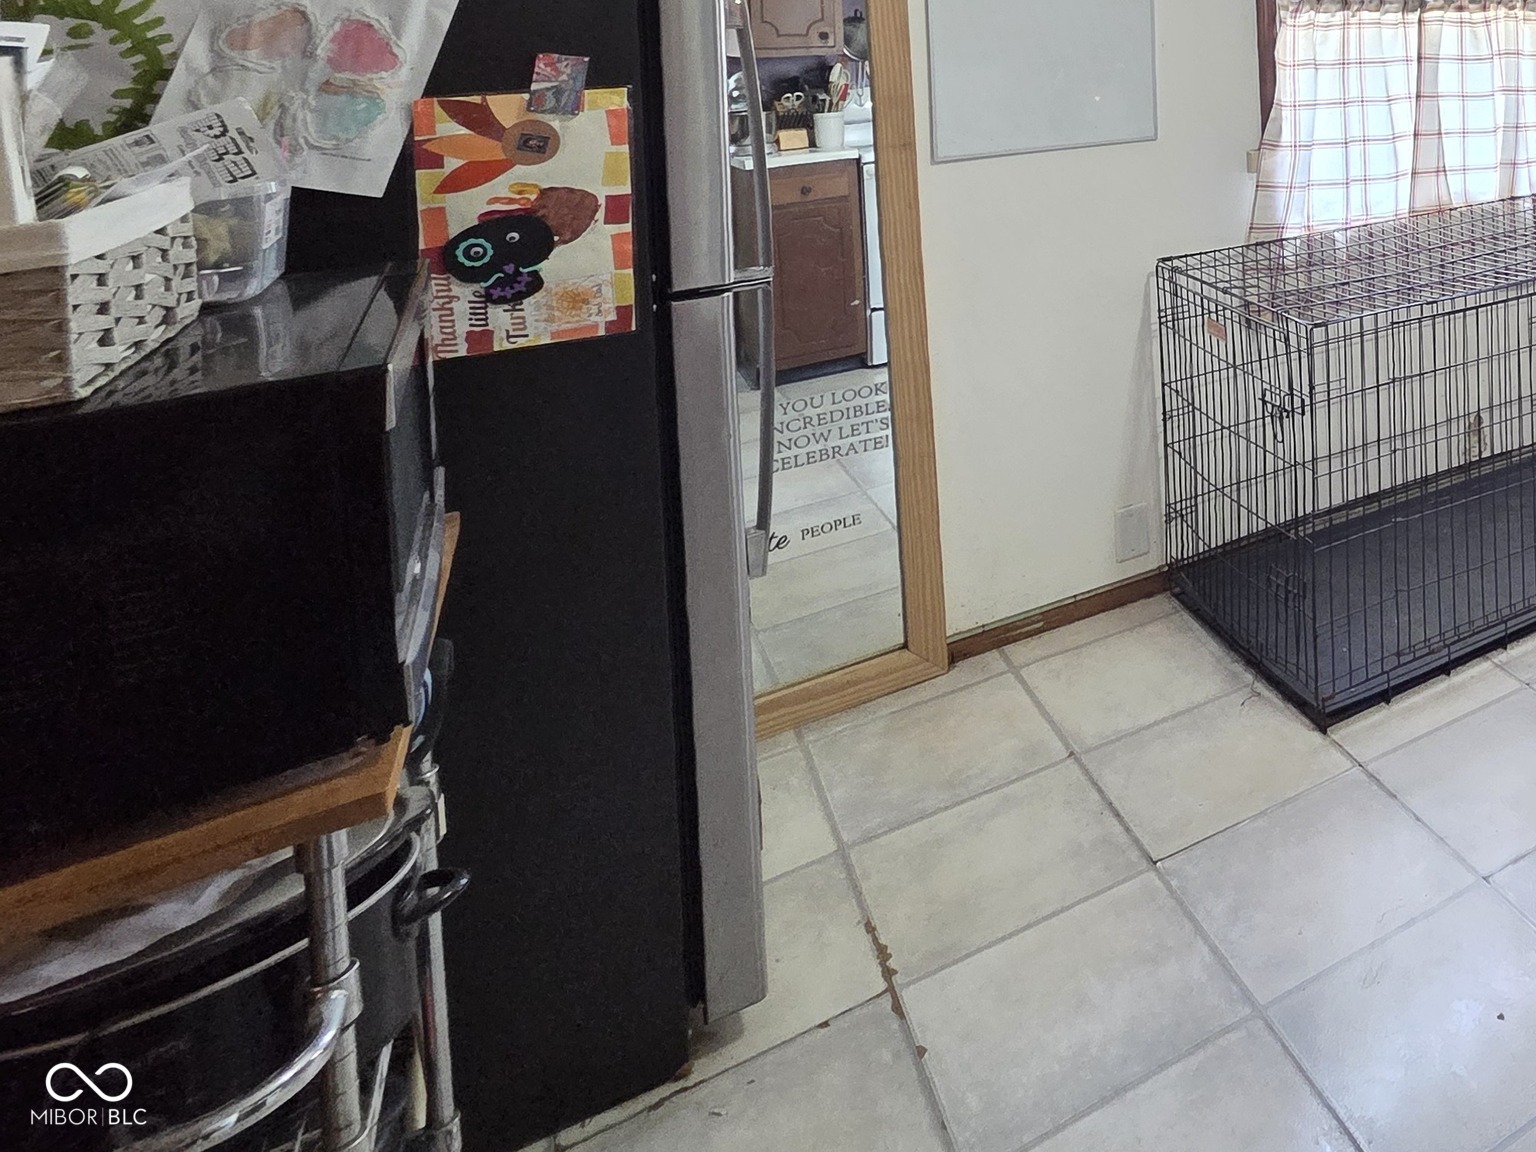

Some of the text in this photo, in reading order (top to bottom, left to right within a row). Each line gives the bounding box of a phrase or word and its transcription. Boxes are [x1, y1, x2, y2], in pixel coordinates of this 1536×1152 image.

[431, 274, 460, 359] Thankful
[468, 290, 489, 328] little
[779, 381, 888, 416] YOU LOOK
[777, 416, 890, 454] NOW LET'S
[801, 513, 863, 541] PEOPLE
